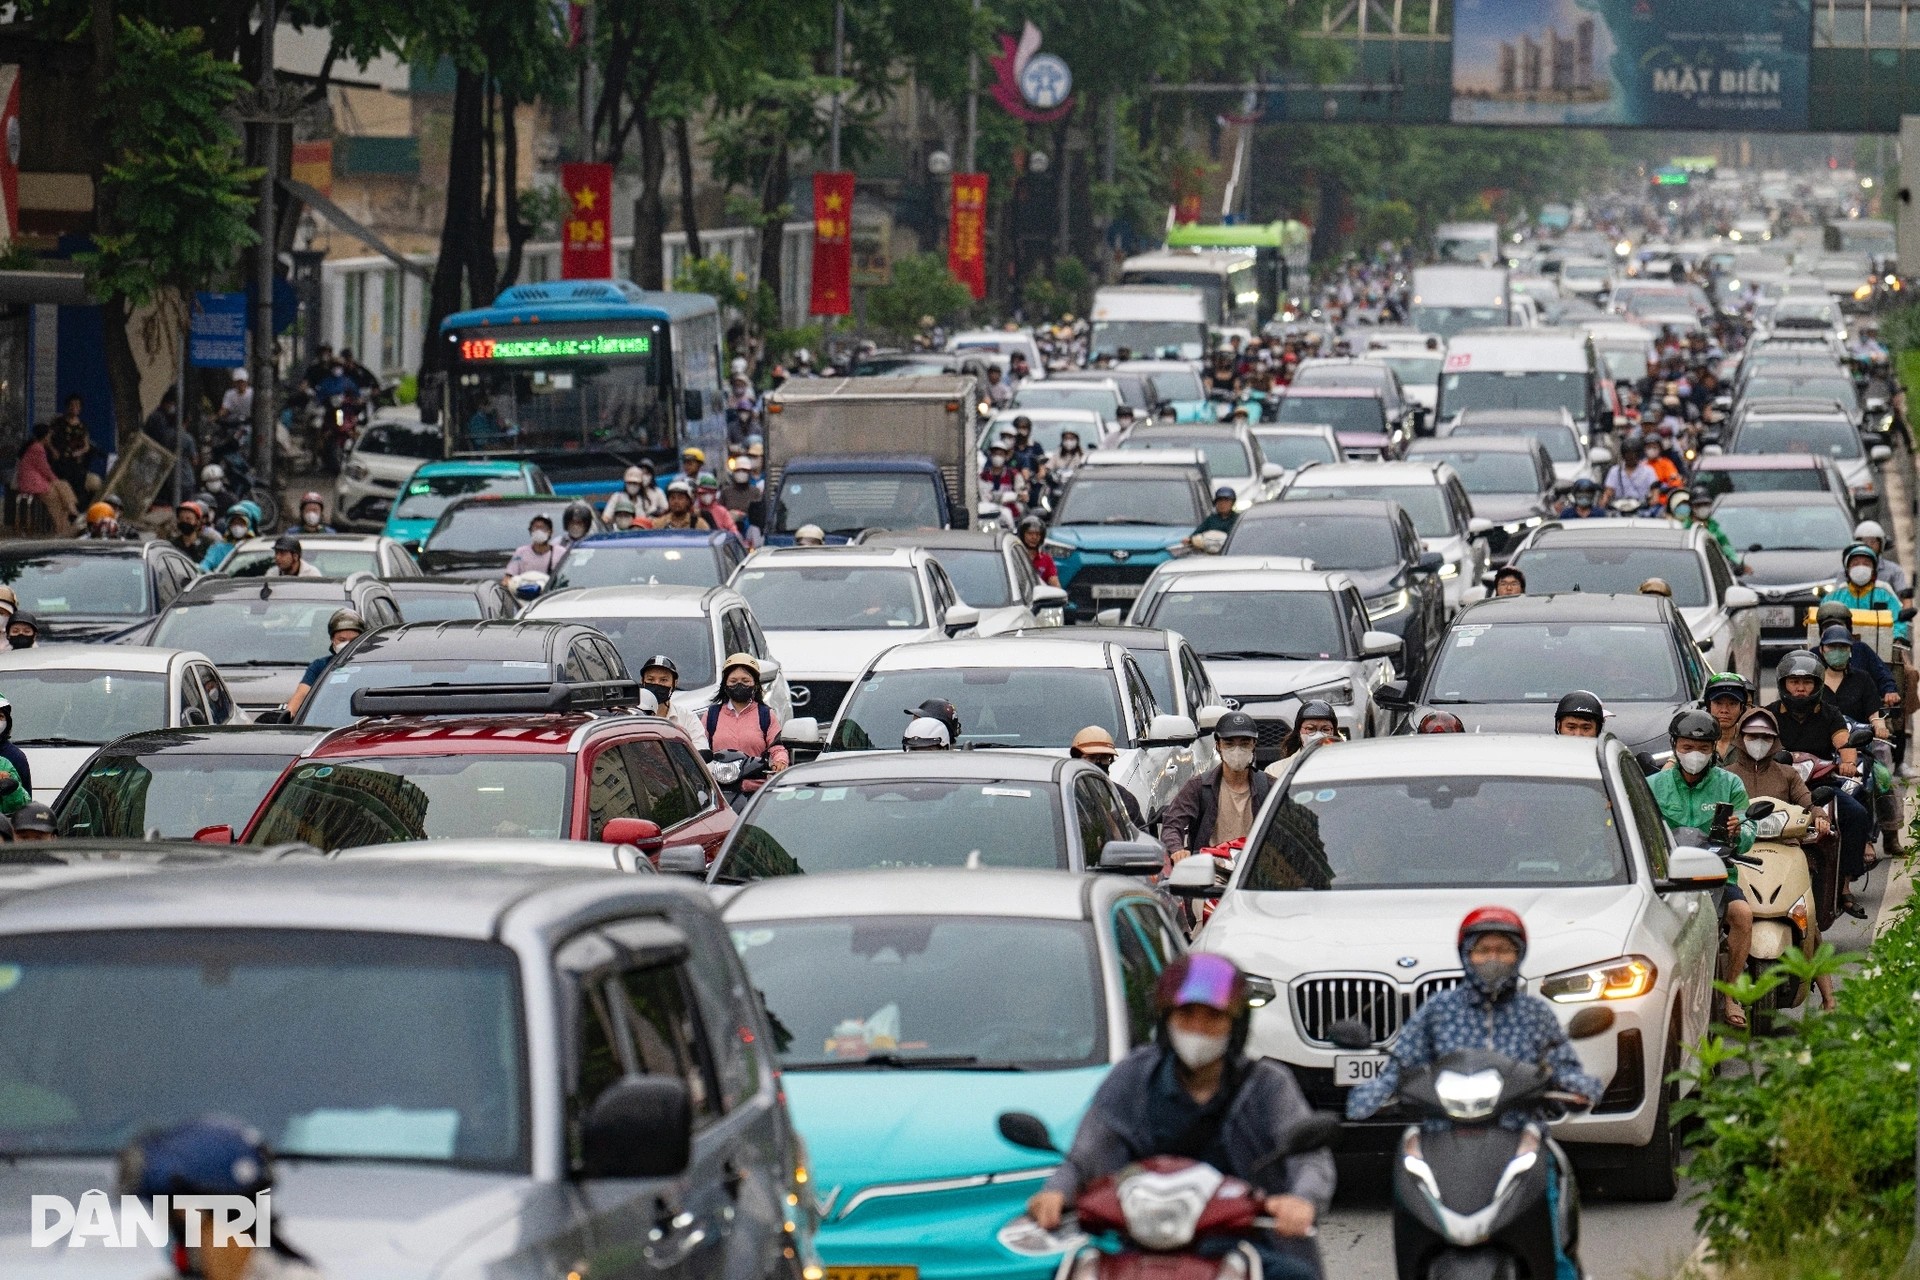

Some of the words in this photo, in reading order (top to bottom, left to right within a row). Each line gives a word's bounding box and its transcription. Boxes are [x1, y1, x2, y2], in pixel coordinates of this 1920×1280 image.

[570, 220, 604, 242] 19-5
[462, 339, 495, 359] 107
[1701, 803, 1717, 811] Gra
[1348, 1060, 1385, 1079] 30K
